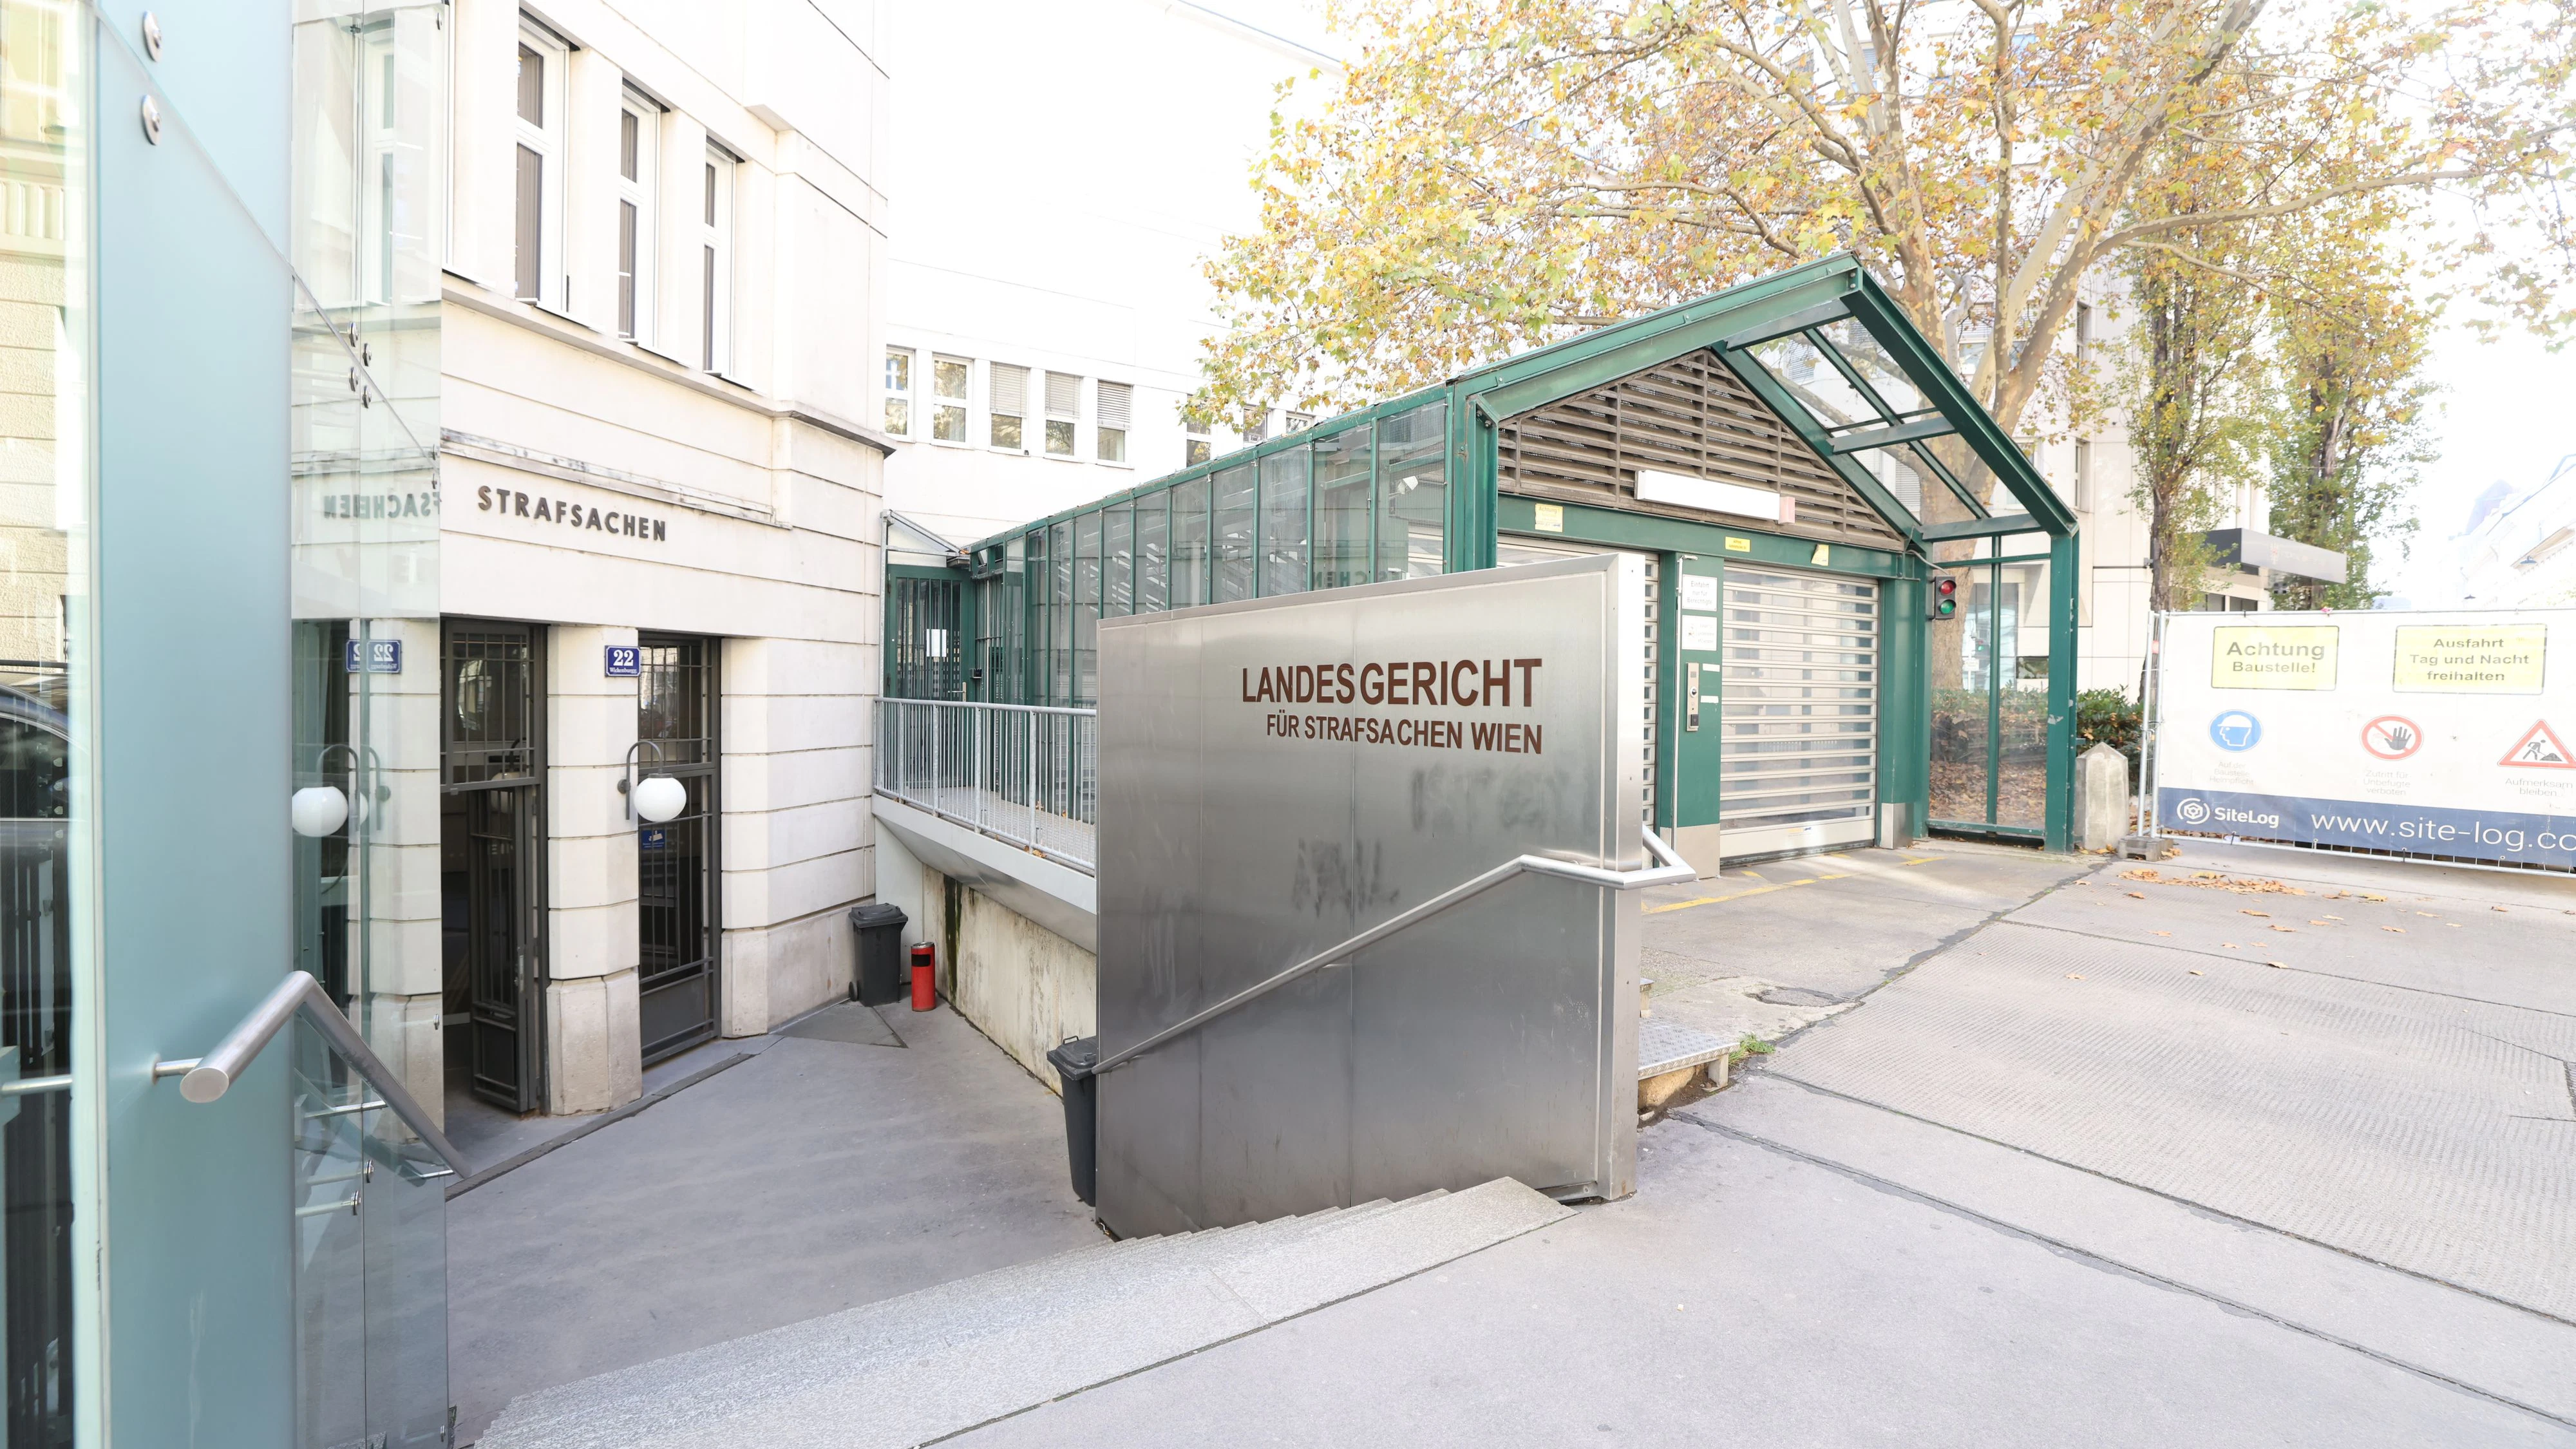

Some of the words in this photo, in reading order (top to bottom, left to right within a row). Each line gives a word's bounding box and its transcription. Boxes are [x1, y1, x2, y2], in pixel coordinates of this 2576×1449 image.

[478, 486, 666, 542] STRAFSACHEN
[2433, 639, 2505, 648] Ausfahrt
[2226, 641, 2325, 660] Achtung
[613, 649, 634, 666] 22
[2410, 654, 2439, 666] Tag
[2444, 655, 2474, 664] und
[2480, 654, 2530, 664] Nacht
[2233, 661, 2315, 673] Baustelle!
[2427, 671, 2505, 681] freihalten
[1242, 658, 1542, 708] LANDESGERICHT
[1267, 709, 1300, 738] FÜR
[1304, 715, 1463, 749] STRAFSACHEN
[1471, 722, 1542, 754] WIEN
[2214, 768, 2250, 777] Baustelle
[2363, 778, 2410, 788] Unbefugte
[2505, 778, 2573, 788] Aufmerksam
[2519, 787, 2557, 796] bleiben
[2214, 807, 2280, 829] SiteLog
[2311, 813, 2576, 852] www.site-log.co
